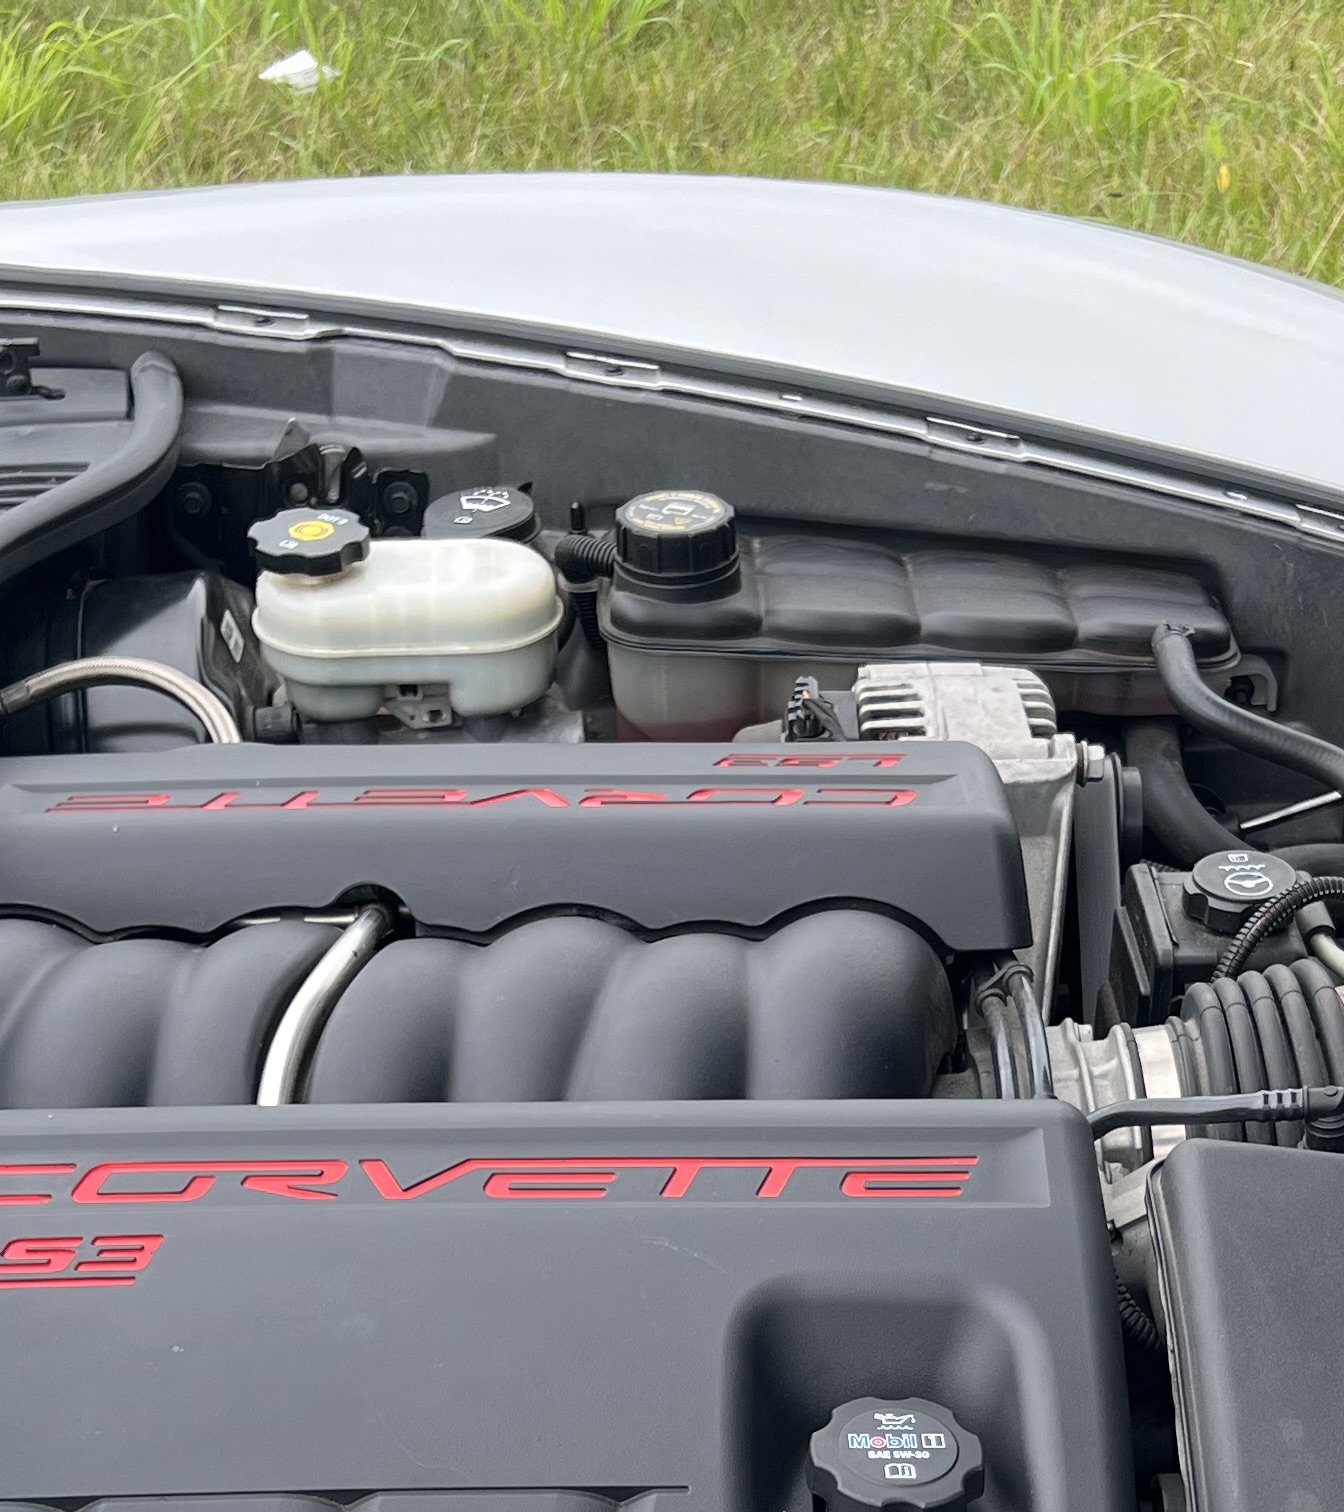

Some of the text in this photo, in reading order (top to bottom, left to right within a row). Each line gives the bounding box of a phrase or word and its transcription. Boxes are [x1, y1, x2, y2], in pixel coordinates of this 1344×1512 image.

[713, 753, 907, 767] LS3
[44, 789, 918, 813] CORVETTE
[847, 1433, 918, 1449] Mobil
[867, 1450, 930, 1459] SAE 5W-30
